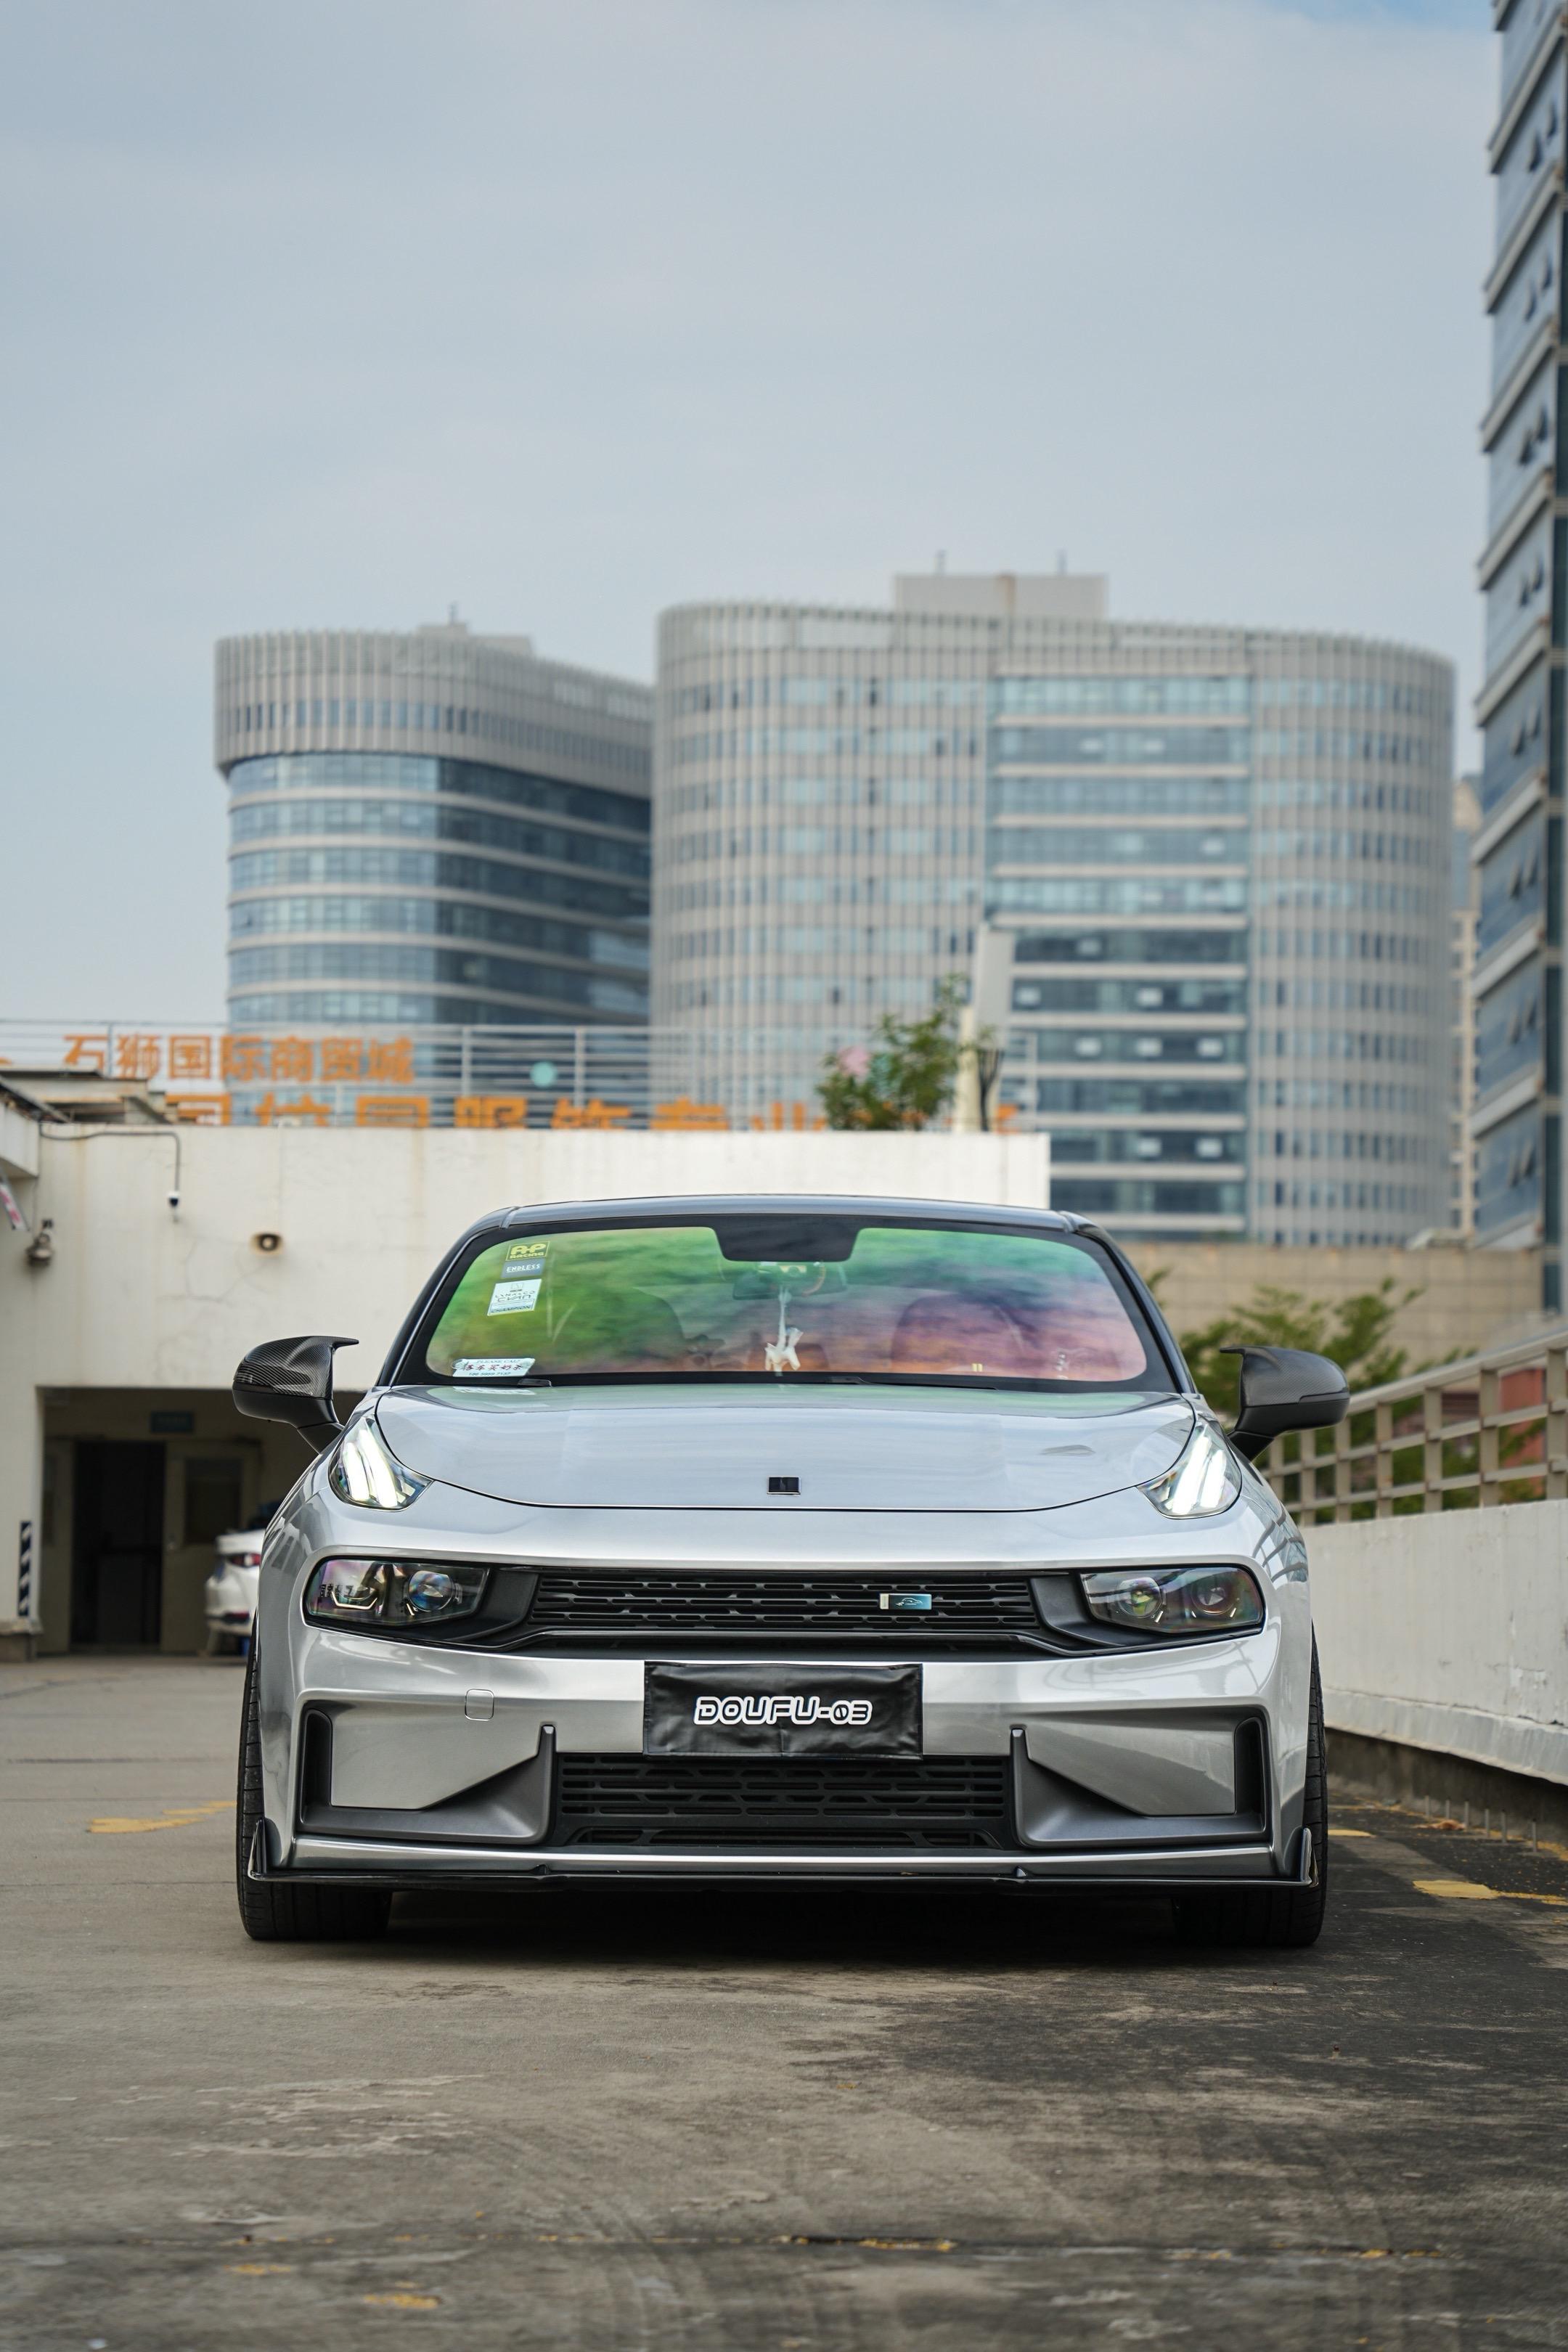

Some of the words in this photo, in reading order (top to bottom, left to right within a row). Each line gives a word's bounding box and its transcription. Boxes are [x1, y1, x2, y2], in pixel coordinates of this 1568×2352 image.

[62, 1033, 415, 1083] 石狮国际商贸城
[506, 1263, 541, 1273] ENDLESS
[693, 1696, 873, 1725] DOUFU-03
